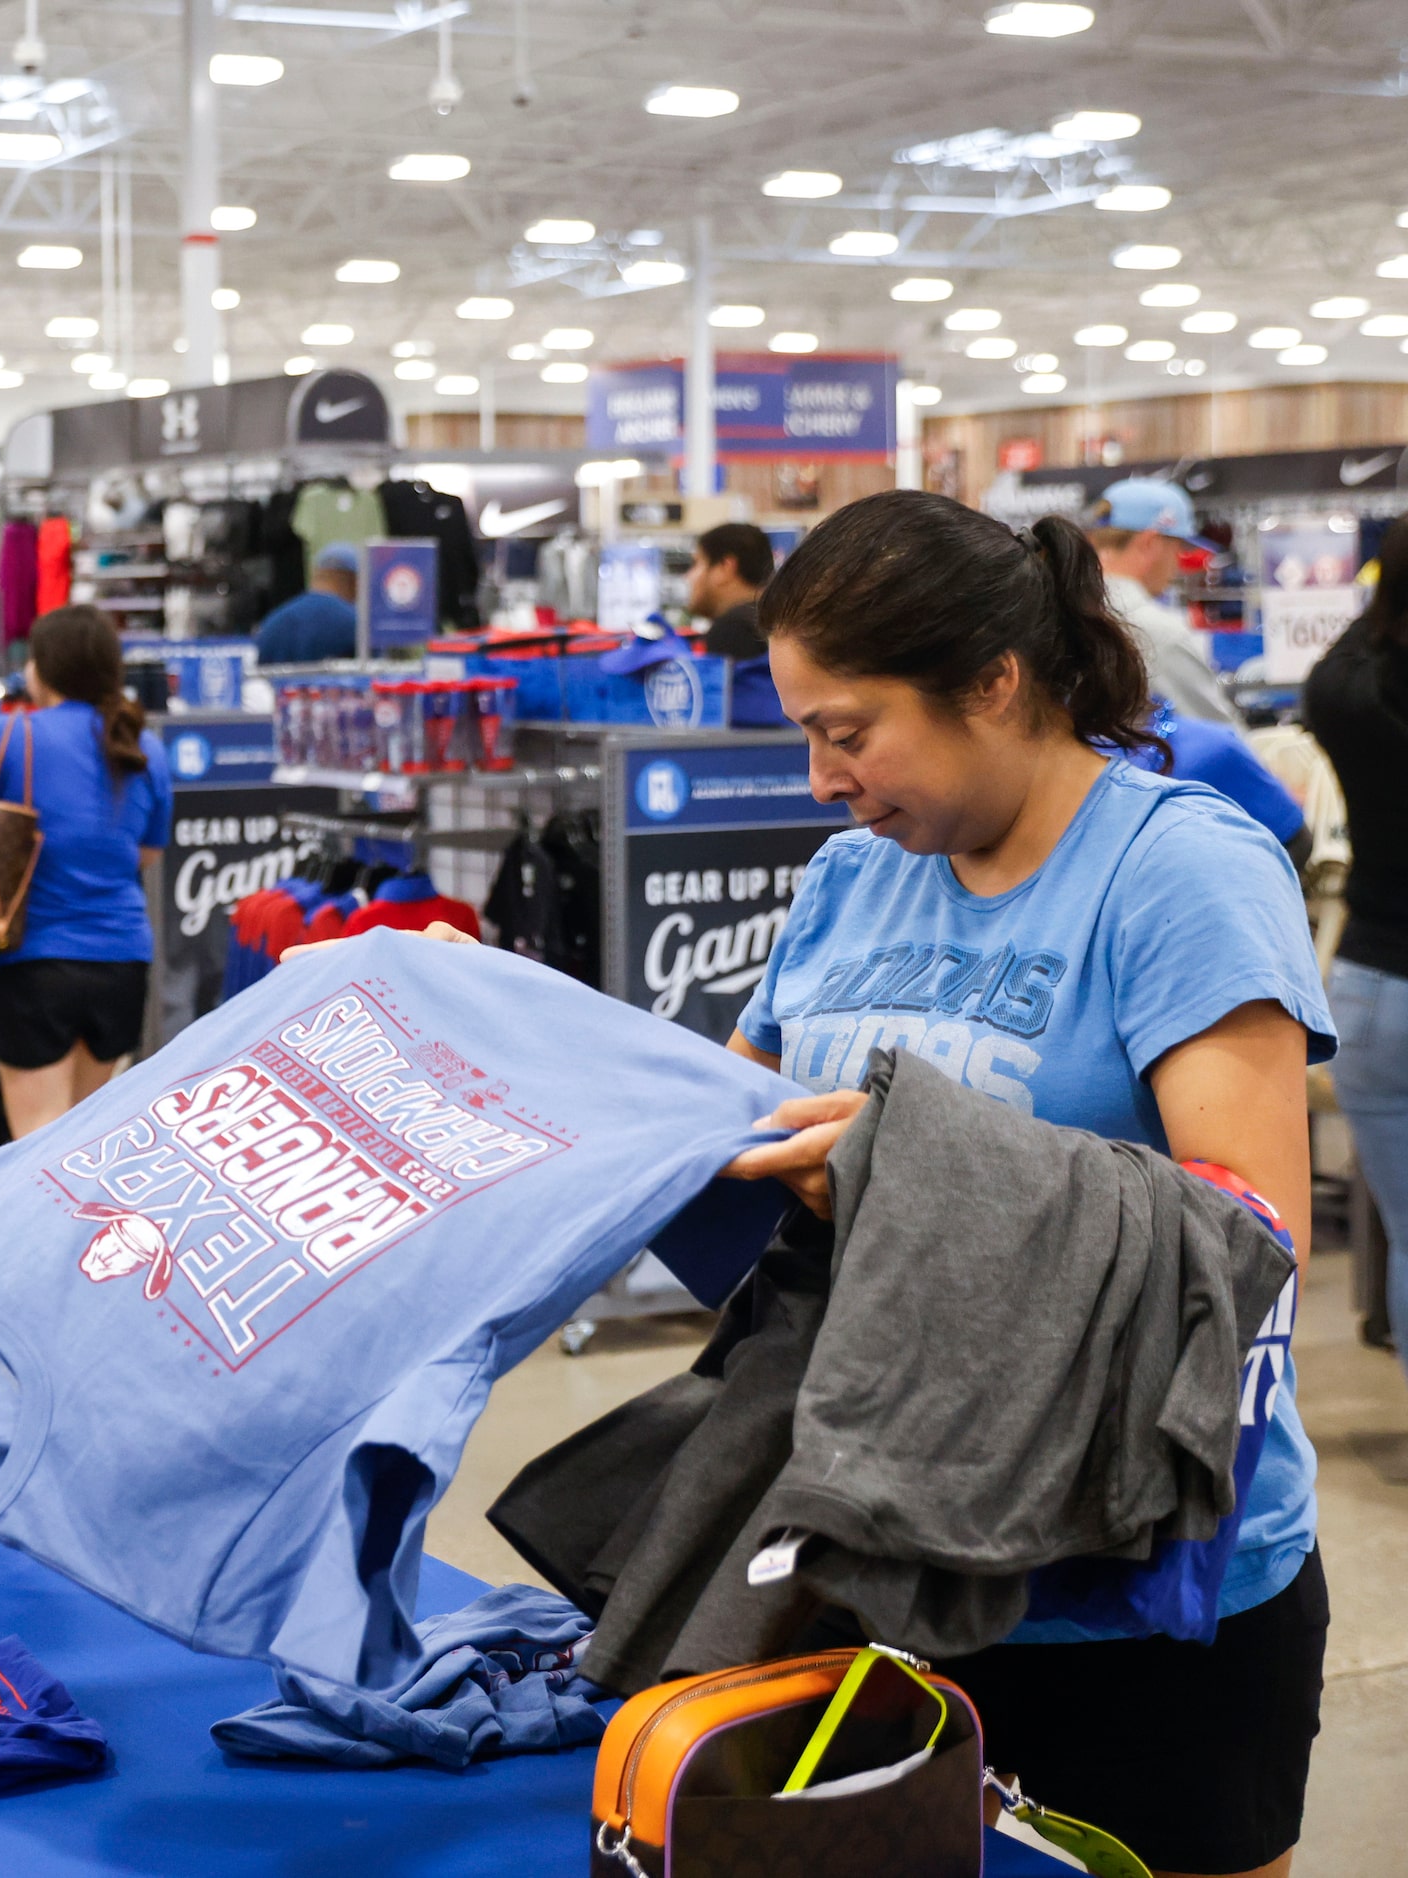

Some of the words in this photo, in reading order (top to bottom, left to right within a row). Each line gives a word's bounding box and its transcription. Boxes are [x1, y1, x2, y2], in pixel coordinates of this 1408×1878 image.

[175, 817, 241, 847] GEAR
[244, 815, 279, 844] UP
[645, 869, 723, 906] GEAR
[728, 866, 769, 901] UP
[644, 906, 790, 1020] Gam
[258, 1043, 315, 1097] LEAGUE
[279, 995, 550, 1181] CHAMPIONS
[312, 1089, 400, 1167] AMERICAN
[149, 1064, 434, 1278] RANGERS
[399, 1159, 454, 1201] 2023
[61, 1116, 308, 1355] TEXAS
